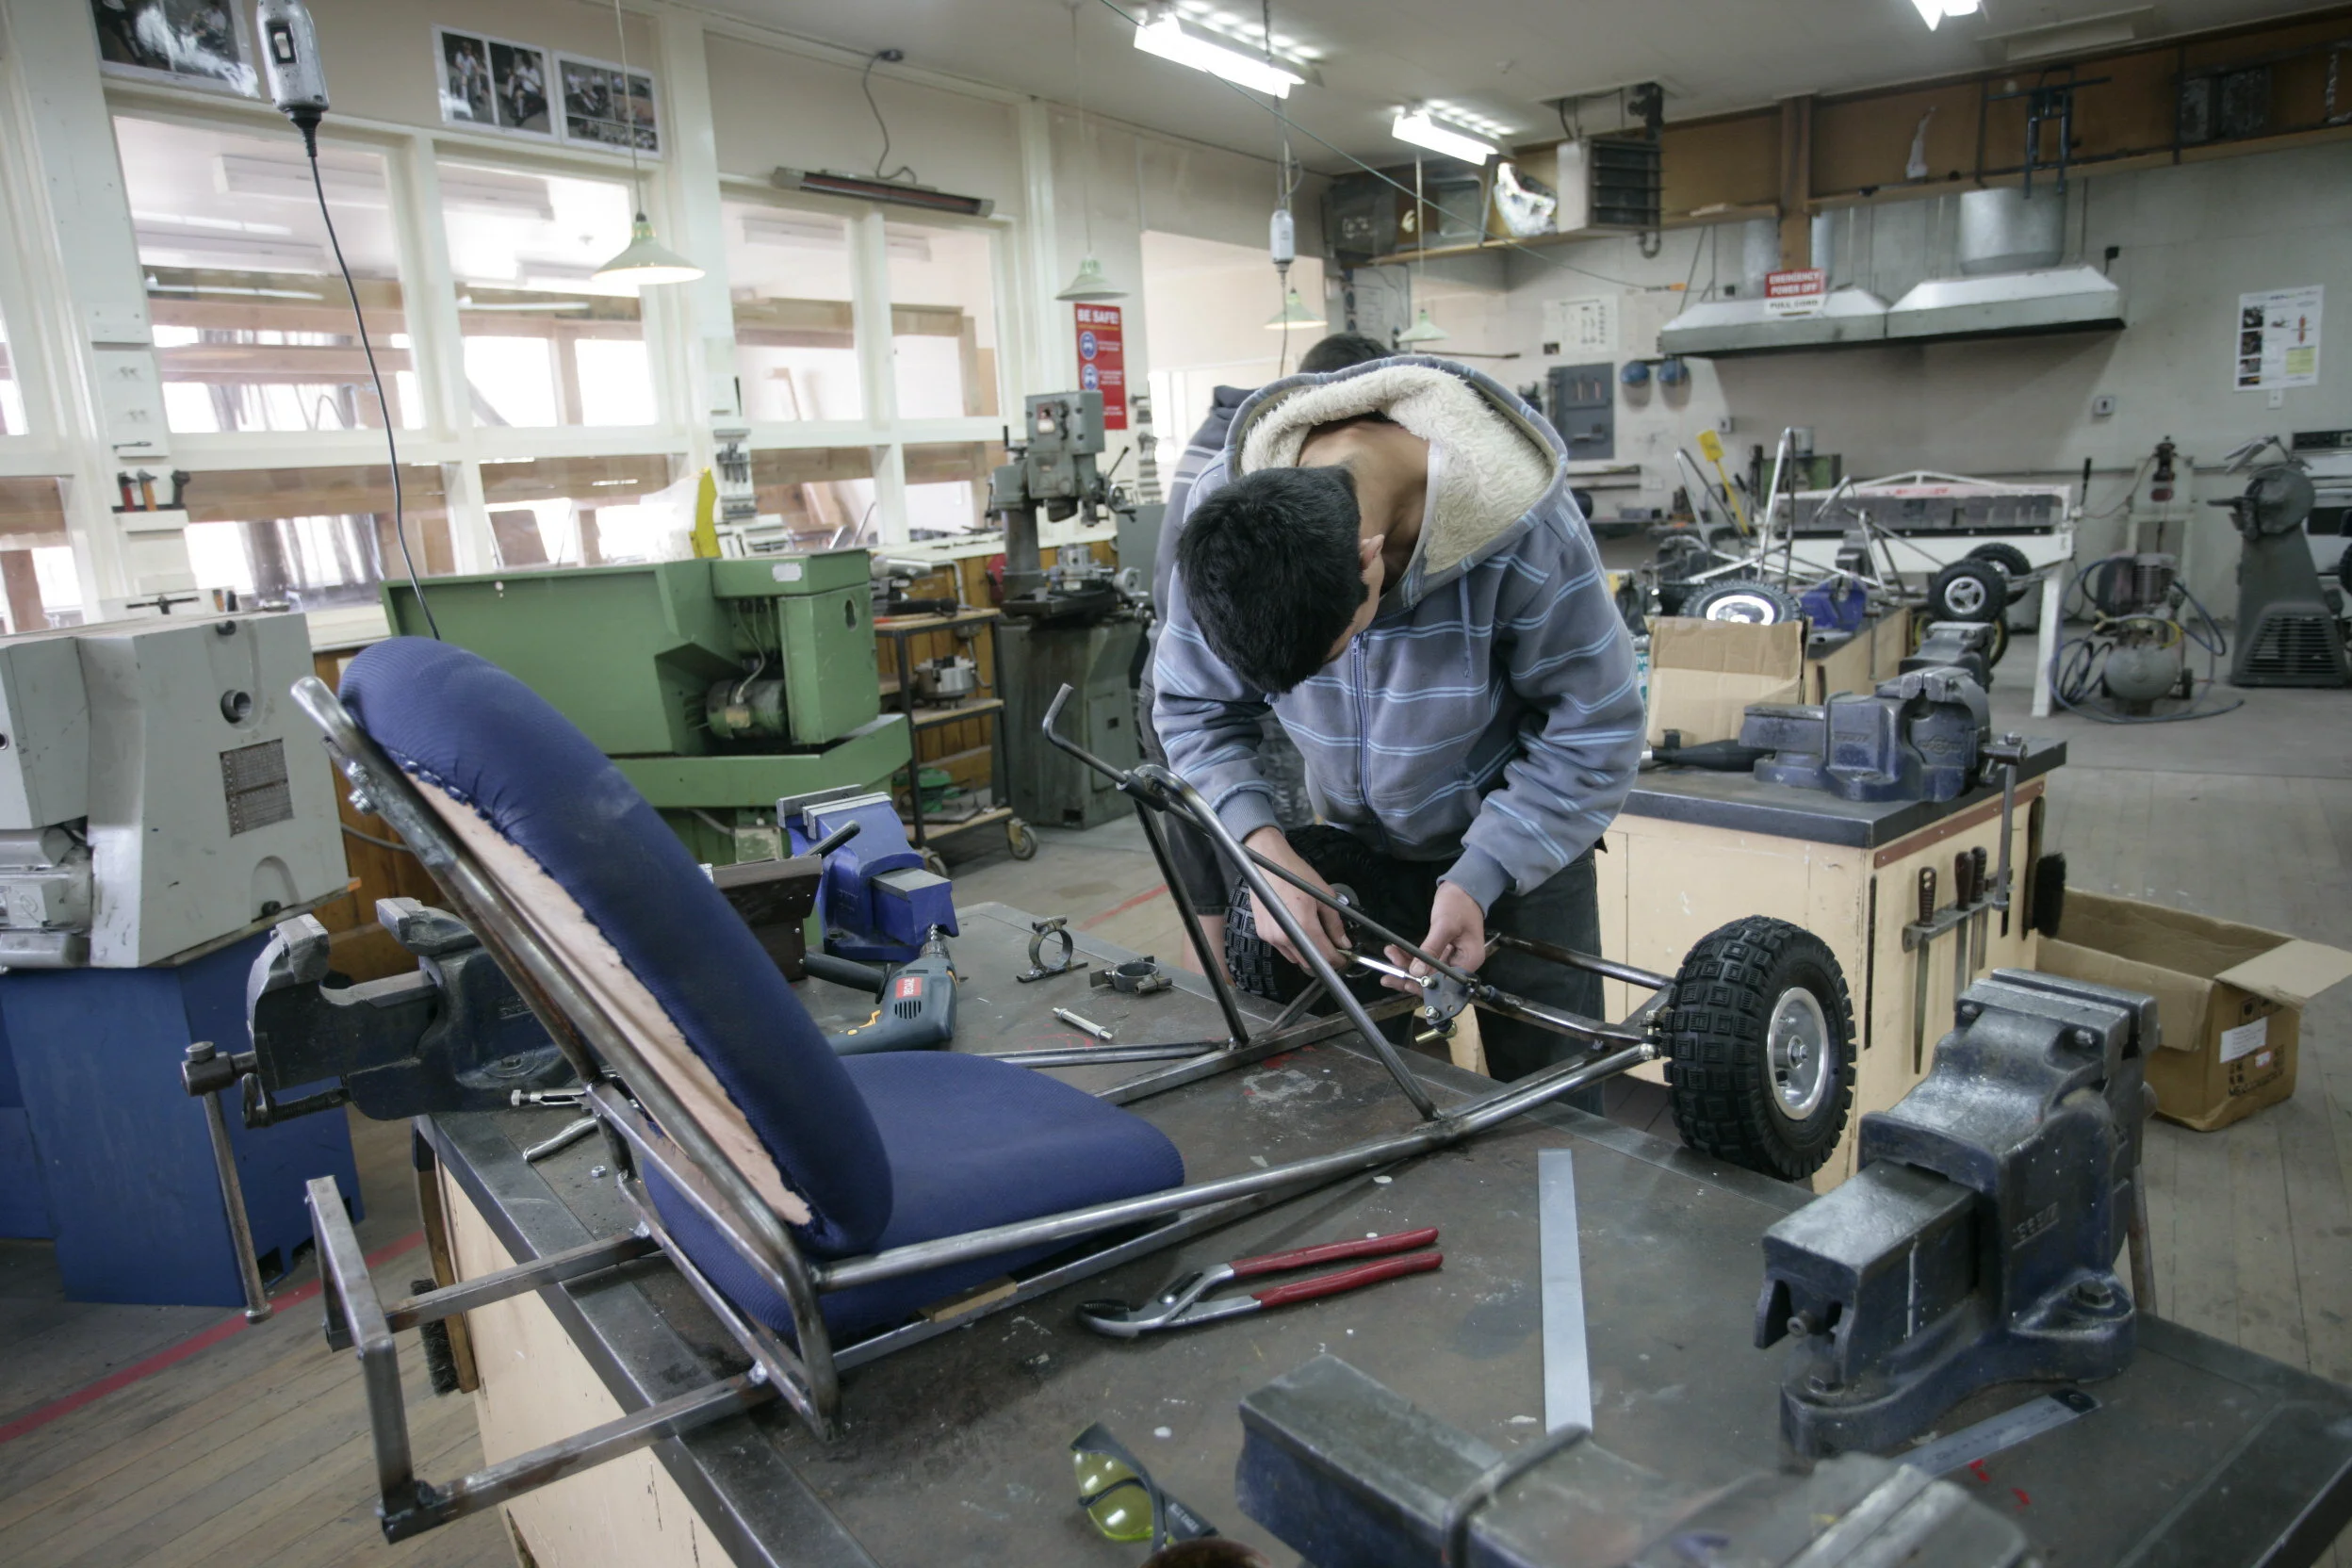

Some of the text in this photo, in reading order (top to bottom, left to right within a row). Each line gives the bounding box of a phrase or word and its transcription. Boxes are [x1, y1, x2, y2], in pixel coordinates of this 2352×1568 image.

[1769, 271, 1818, 284] EMERGENCY
[1771, 283, 1818, 295] POWER OFF
[1077, 308, 1090, 321] BE
